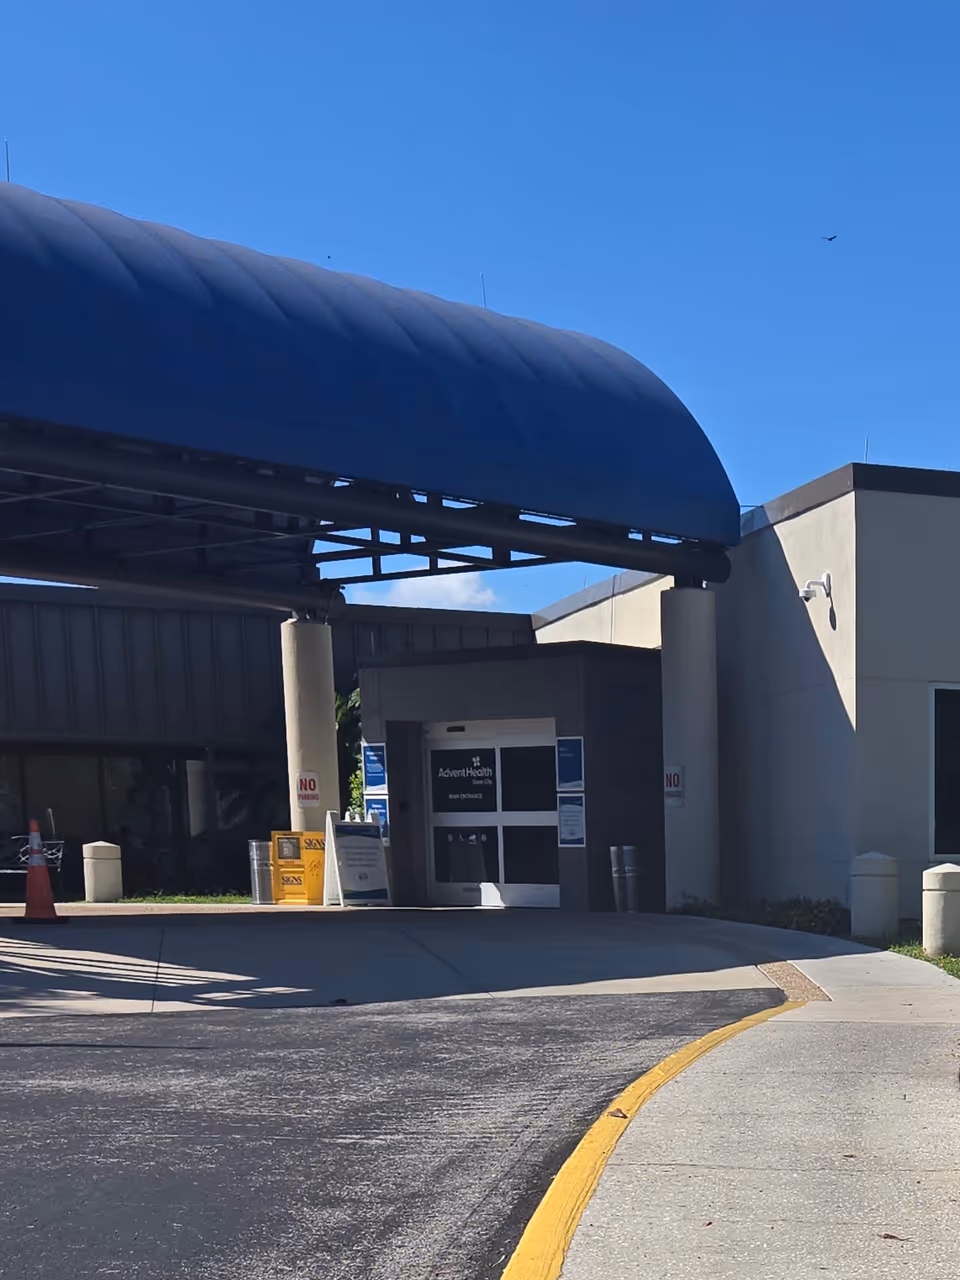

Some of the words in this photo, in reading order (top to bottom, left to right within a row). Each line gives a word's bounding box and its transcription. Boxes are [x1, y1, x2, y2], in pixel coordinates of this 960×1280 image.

[438, 766, 493, 778] AdventHealth
[299, 778, 316, 791] NO
[666, 772, 680, 787] NO
[282, 876, 302, 885] SIGNS
